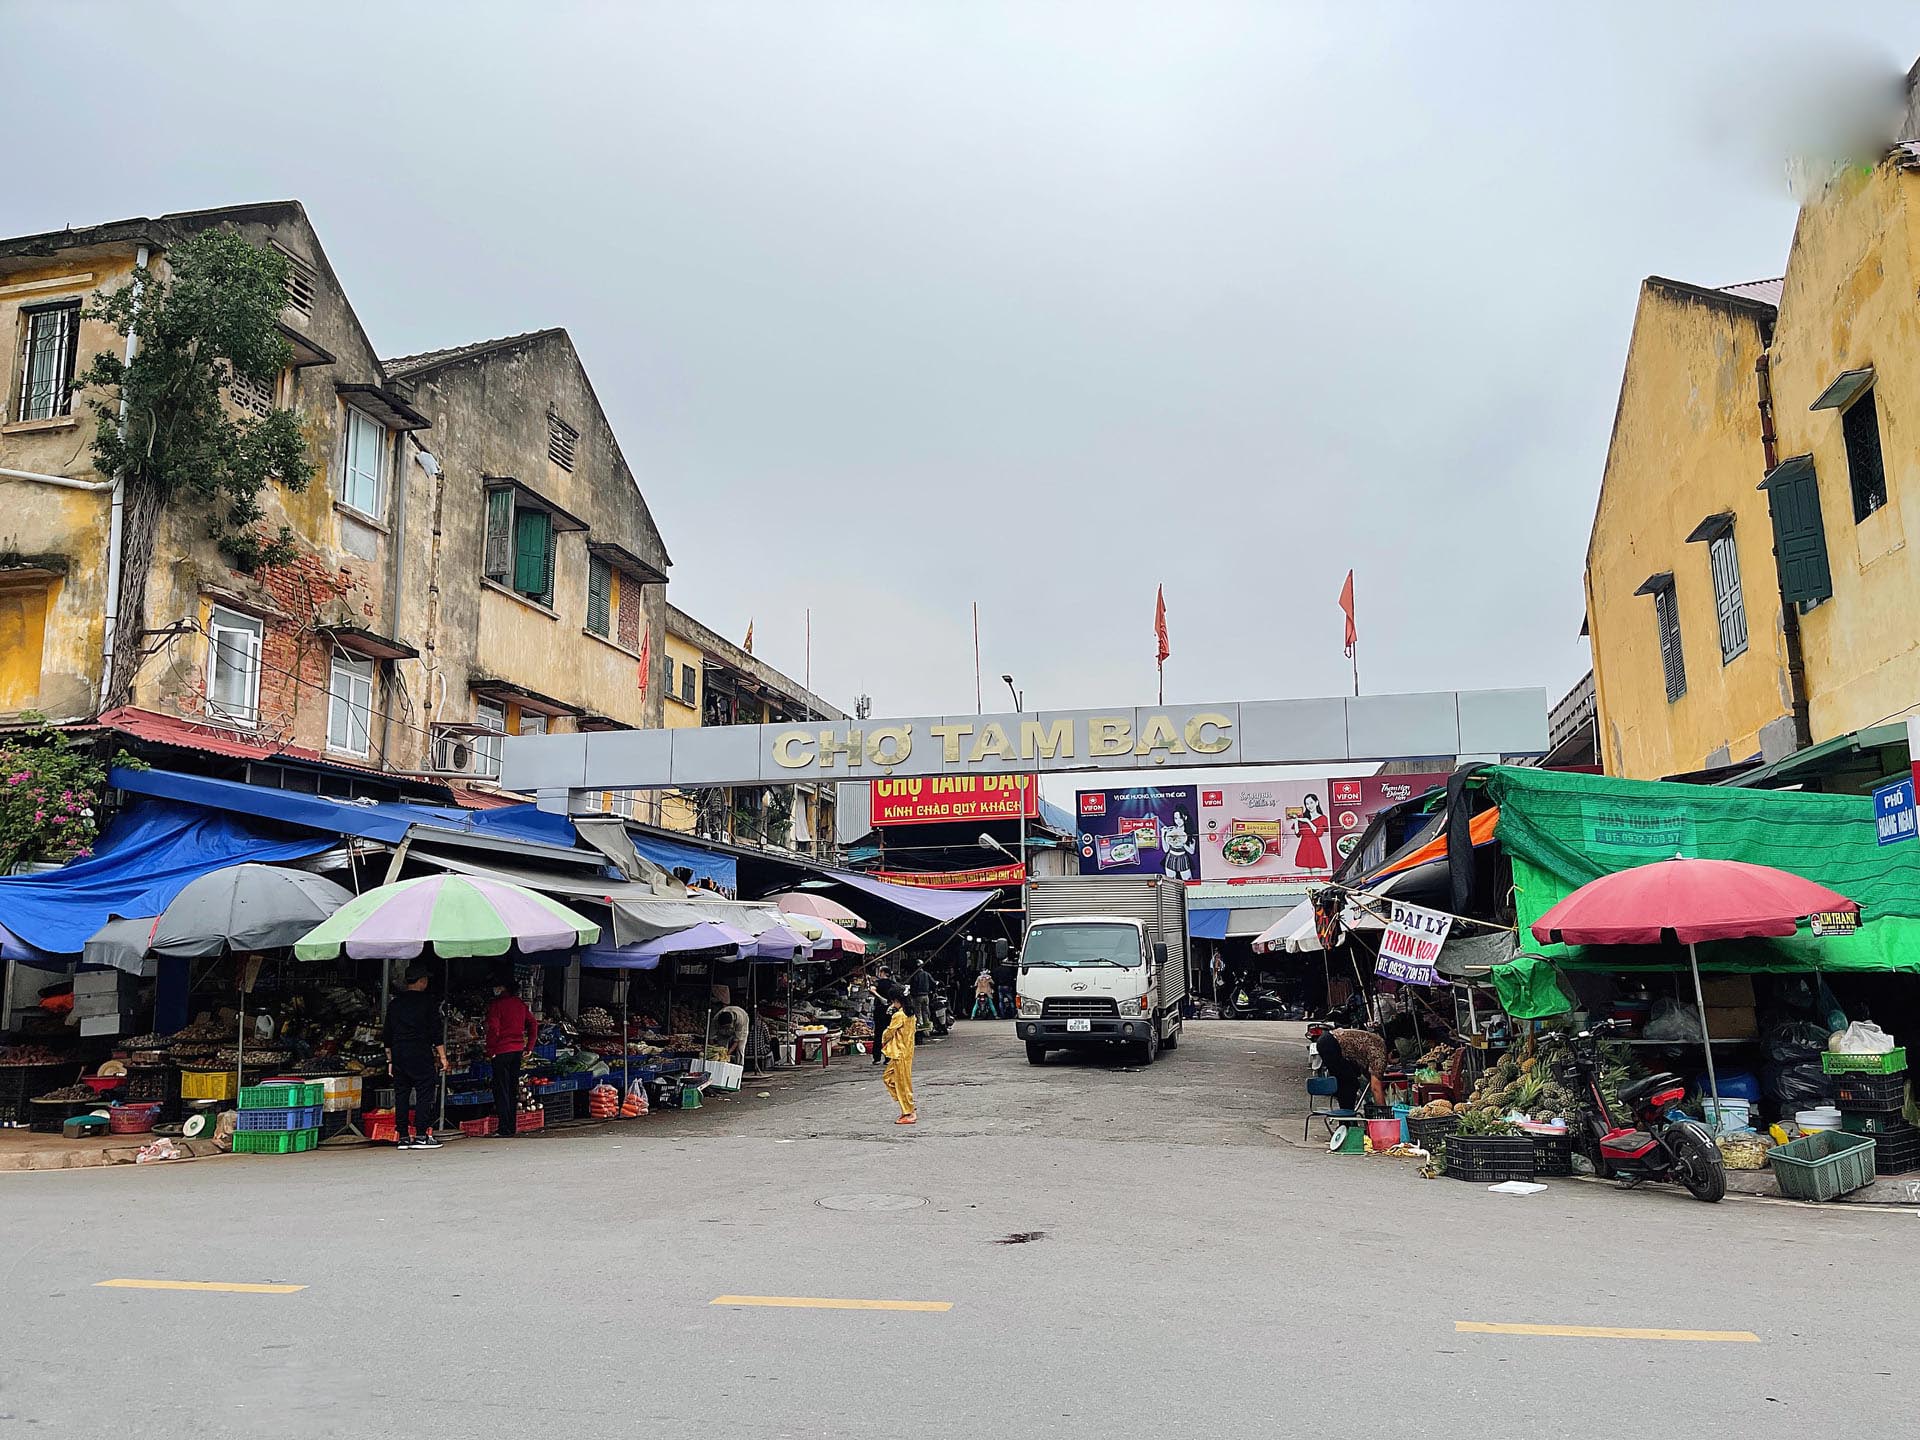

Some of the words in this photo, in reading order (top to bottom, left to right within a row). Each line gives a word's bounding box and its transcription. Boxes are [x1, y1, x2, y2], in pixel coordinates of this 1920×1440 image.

[772, 723, 912, 775] CHỢ
[930, 719, 1075, 762] TAM
[1088, 713, 1233, 764] BẠC
[884, 804, 913, 818] KÍNH
[916, 802, 950, 816] CHÀO
[953, 800, 977, 815] QUÝ
[980, 800, 1022, 813] KHÁCH
[1083, 804, 1104, 812] VIFON
[1884, 786, 1904, 809] PHỐ
[1393, 908, 1423, 930] ĐẠI
[1424, 916, 1449, 936] LÝ
[1384, 930, 1416, 958] THAN
[1415, 939, 1439, 960] HOA
[1387, 960, 1407, 978] 0932
[1417, 967, 1430, 982] 576
